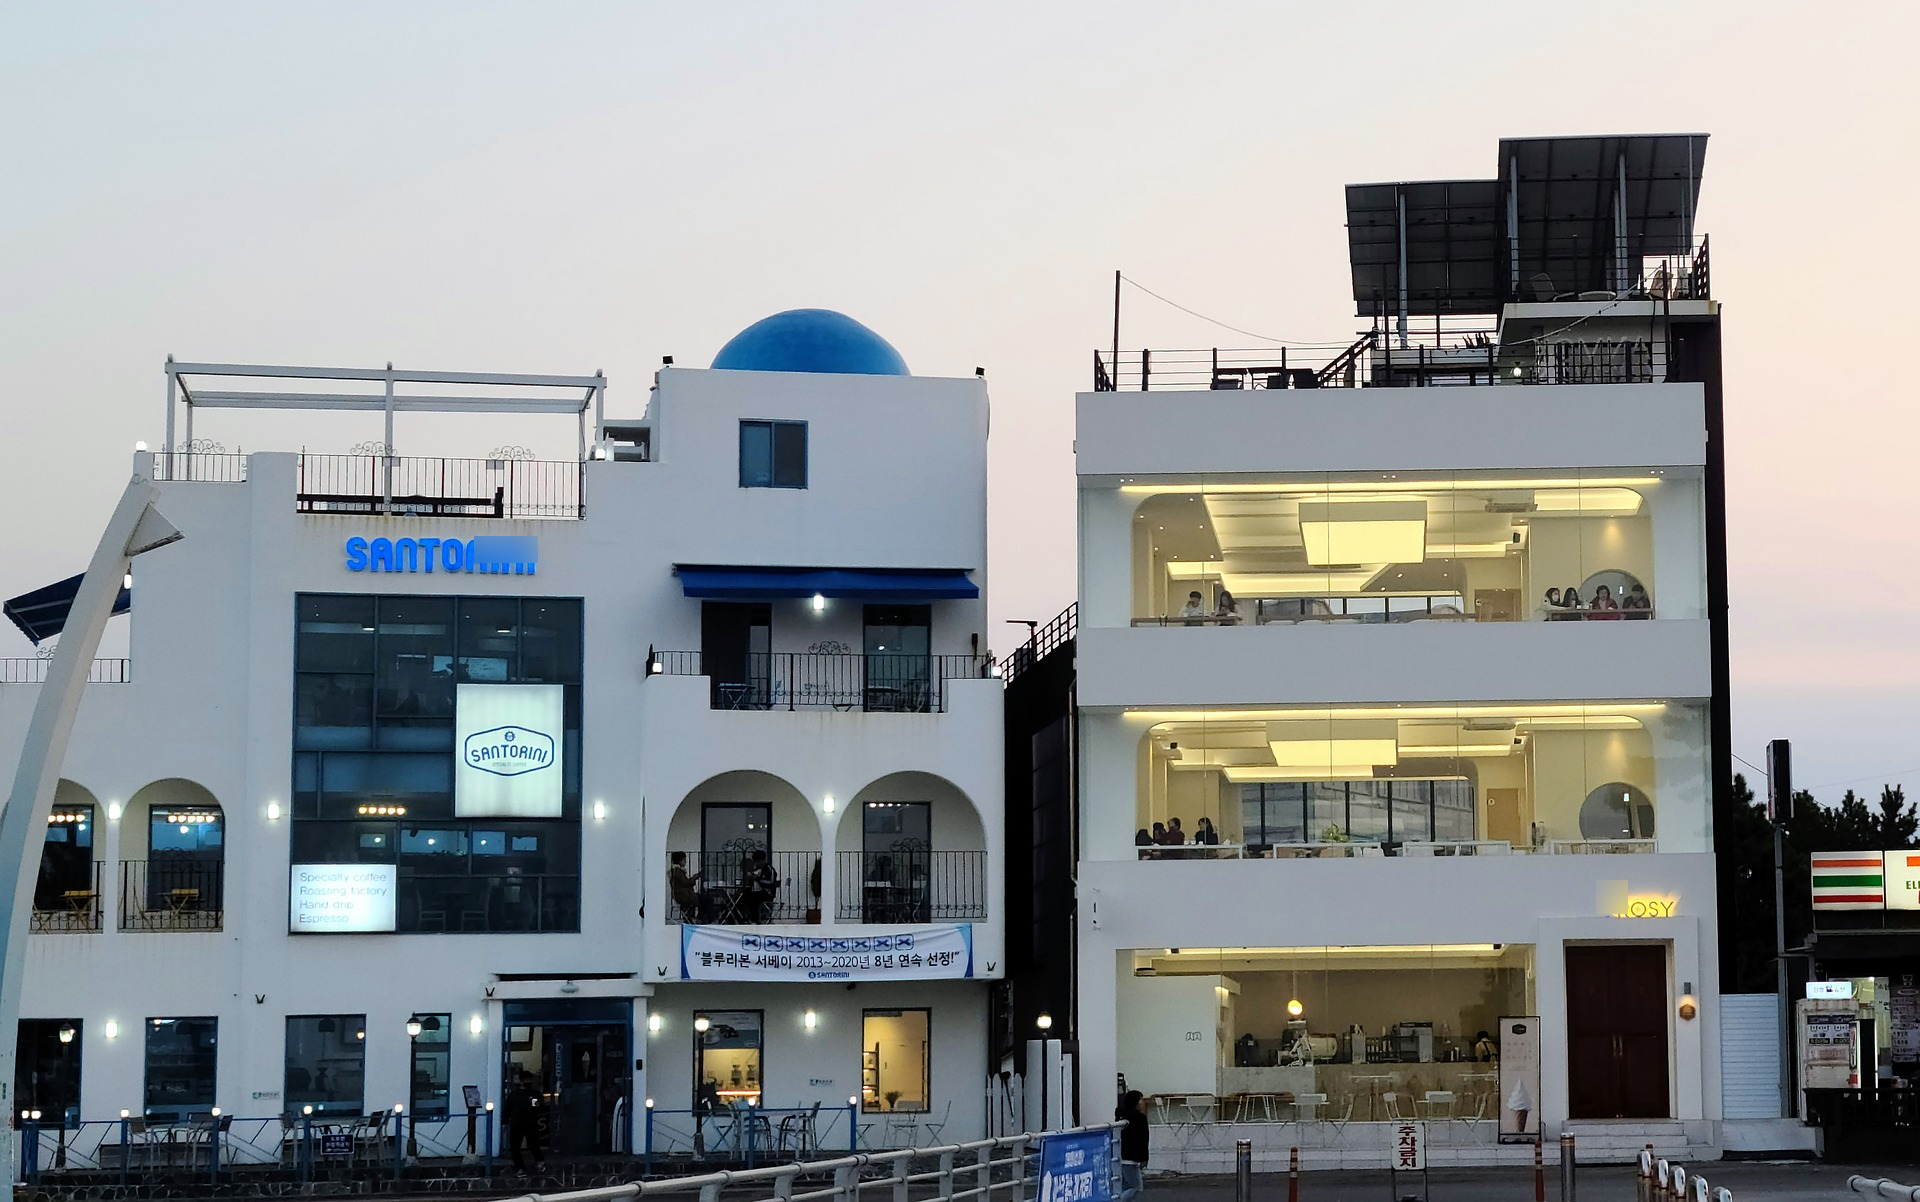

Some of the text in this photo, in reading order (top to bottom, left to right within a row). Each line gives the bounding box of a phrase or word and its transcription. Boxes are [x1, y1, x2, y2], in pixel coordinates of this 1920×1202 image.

[346, 537, 536, 574] SANTO
[471, 745, 548, 763] SANTORINI
[300, 872, 387, 882] Specialty coffee
[300, 886, 387, 896] Roasting factory
[300, 901, 355, 909] Hand drip
[1617, 901, 1674, 918] OSY
[299, 914, 349, 923] Espresso
[755, 955, 791, 969] 서베이
[796, 955, 870, 969] 2013~2020년
[874, 954, 893, 968] 8년
[899, 952, 923, 968] 연속
[1398, 1126, 1417, 1168] 주차금지
